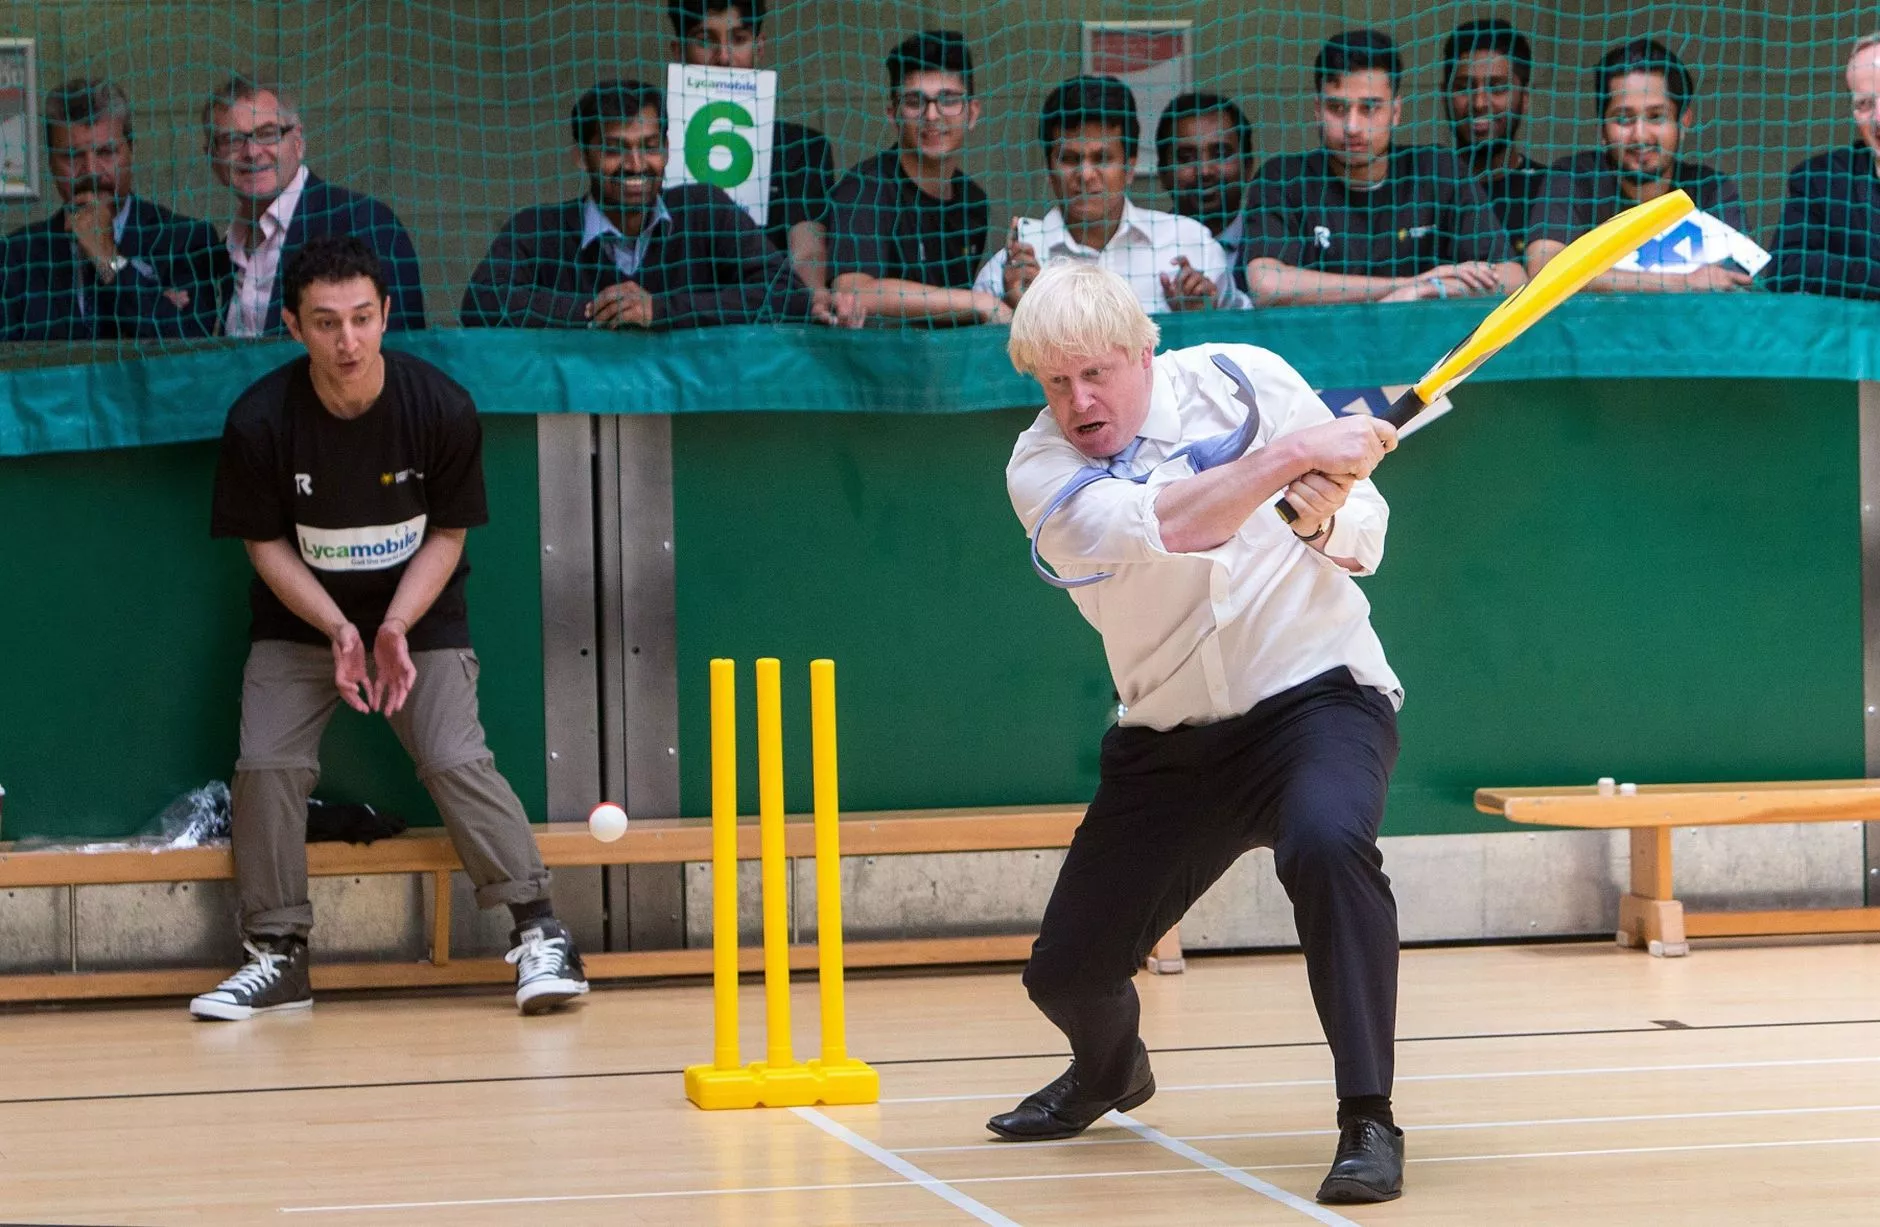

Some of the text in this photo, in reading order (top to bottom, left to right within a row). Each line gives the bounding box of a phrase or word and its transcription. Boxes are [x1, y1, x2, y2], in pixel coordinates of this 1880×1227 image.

[684, 101, 754, 189] 6
[294, 472, 313, 496] R
[301, 531, 418, 559] Lycamobile
